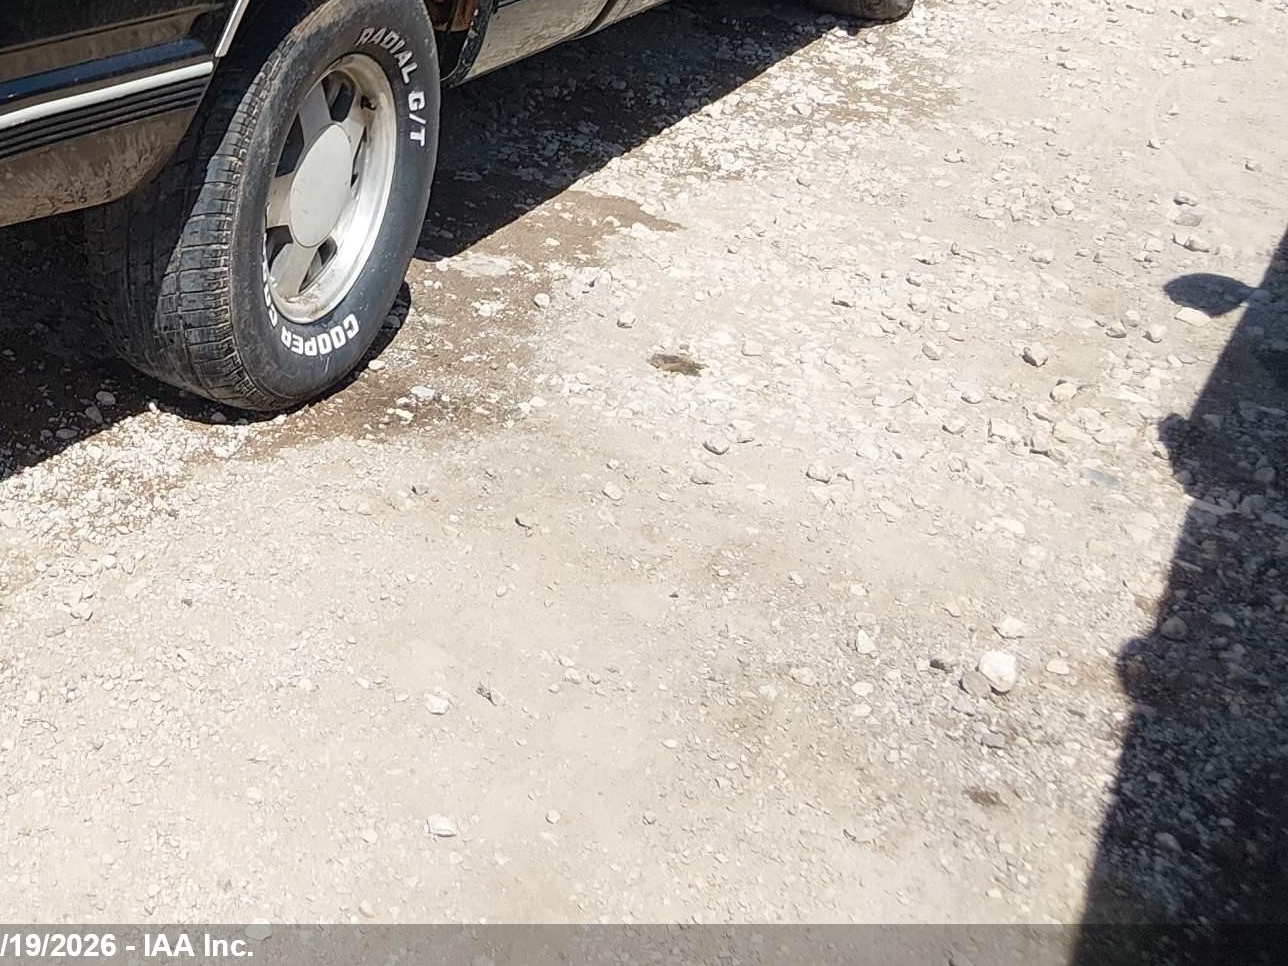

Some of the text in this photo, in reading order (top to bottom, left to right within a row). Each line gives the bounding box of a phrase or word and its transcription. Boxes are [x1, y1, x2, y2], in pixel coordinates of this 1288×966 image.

[354, 26, 427, 147] RADIAL G/T
[280, 313, 361, 356] COOPER
